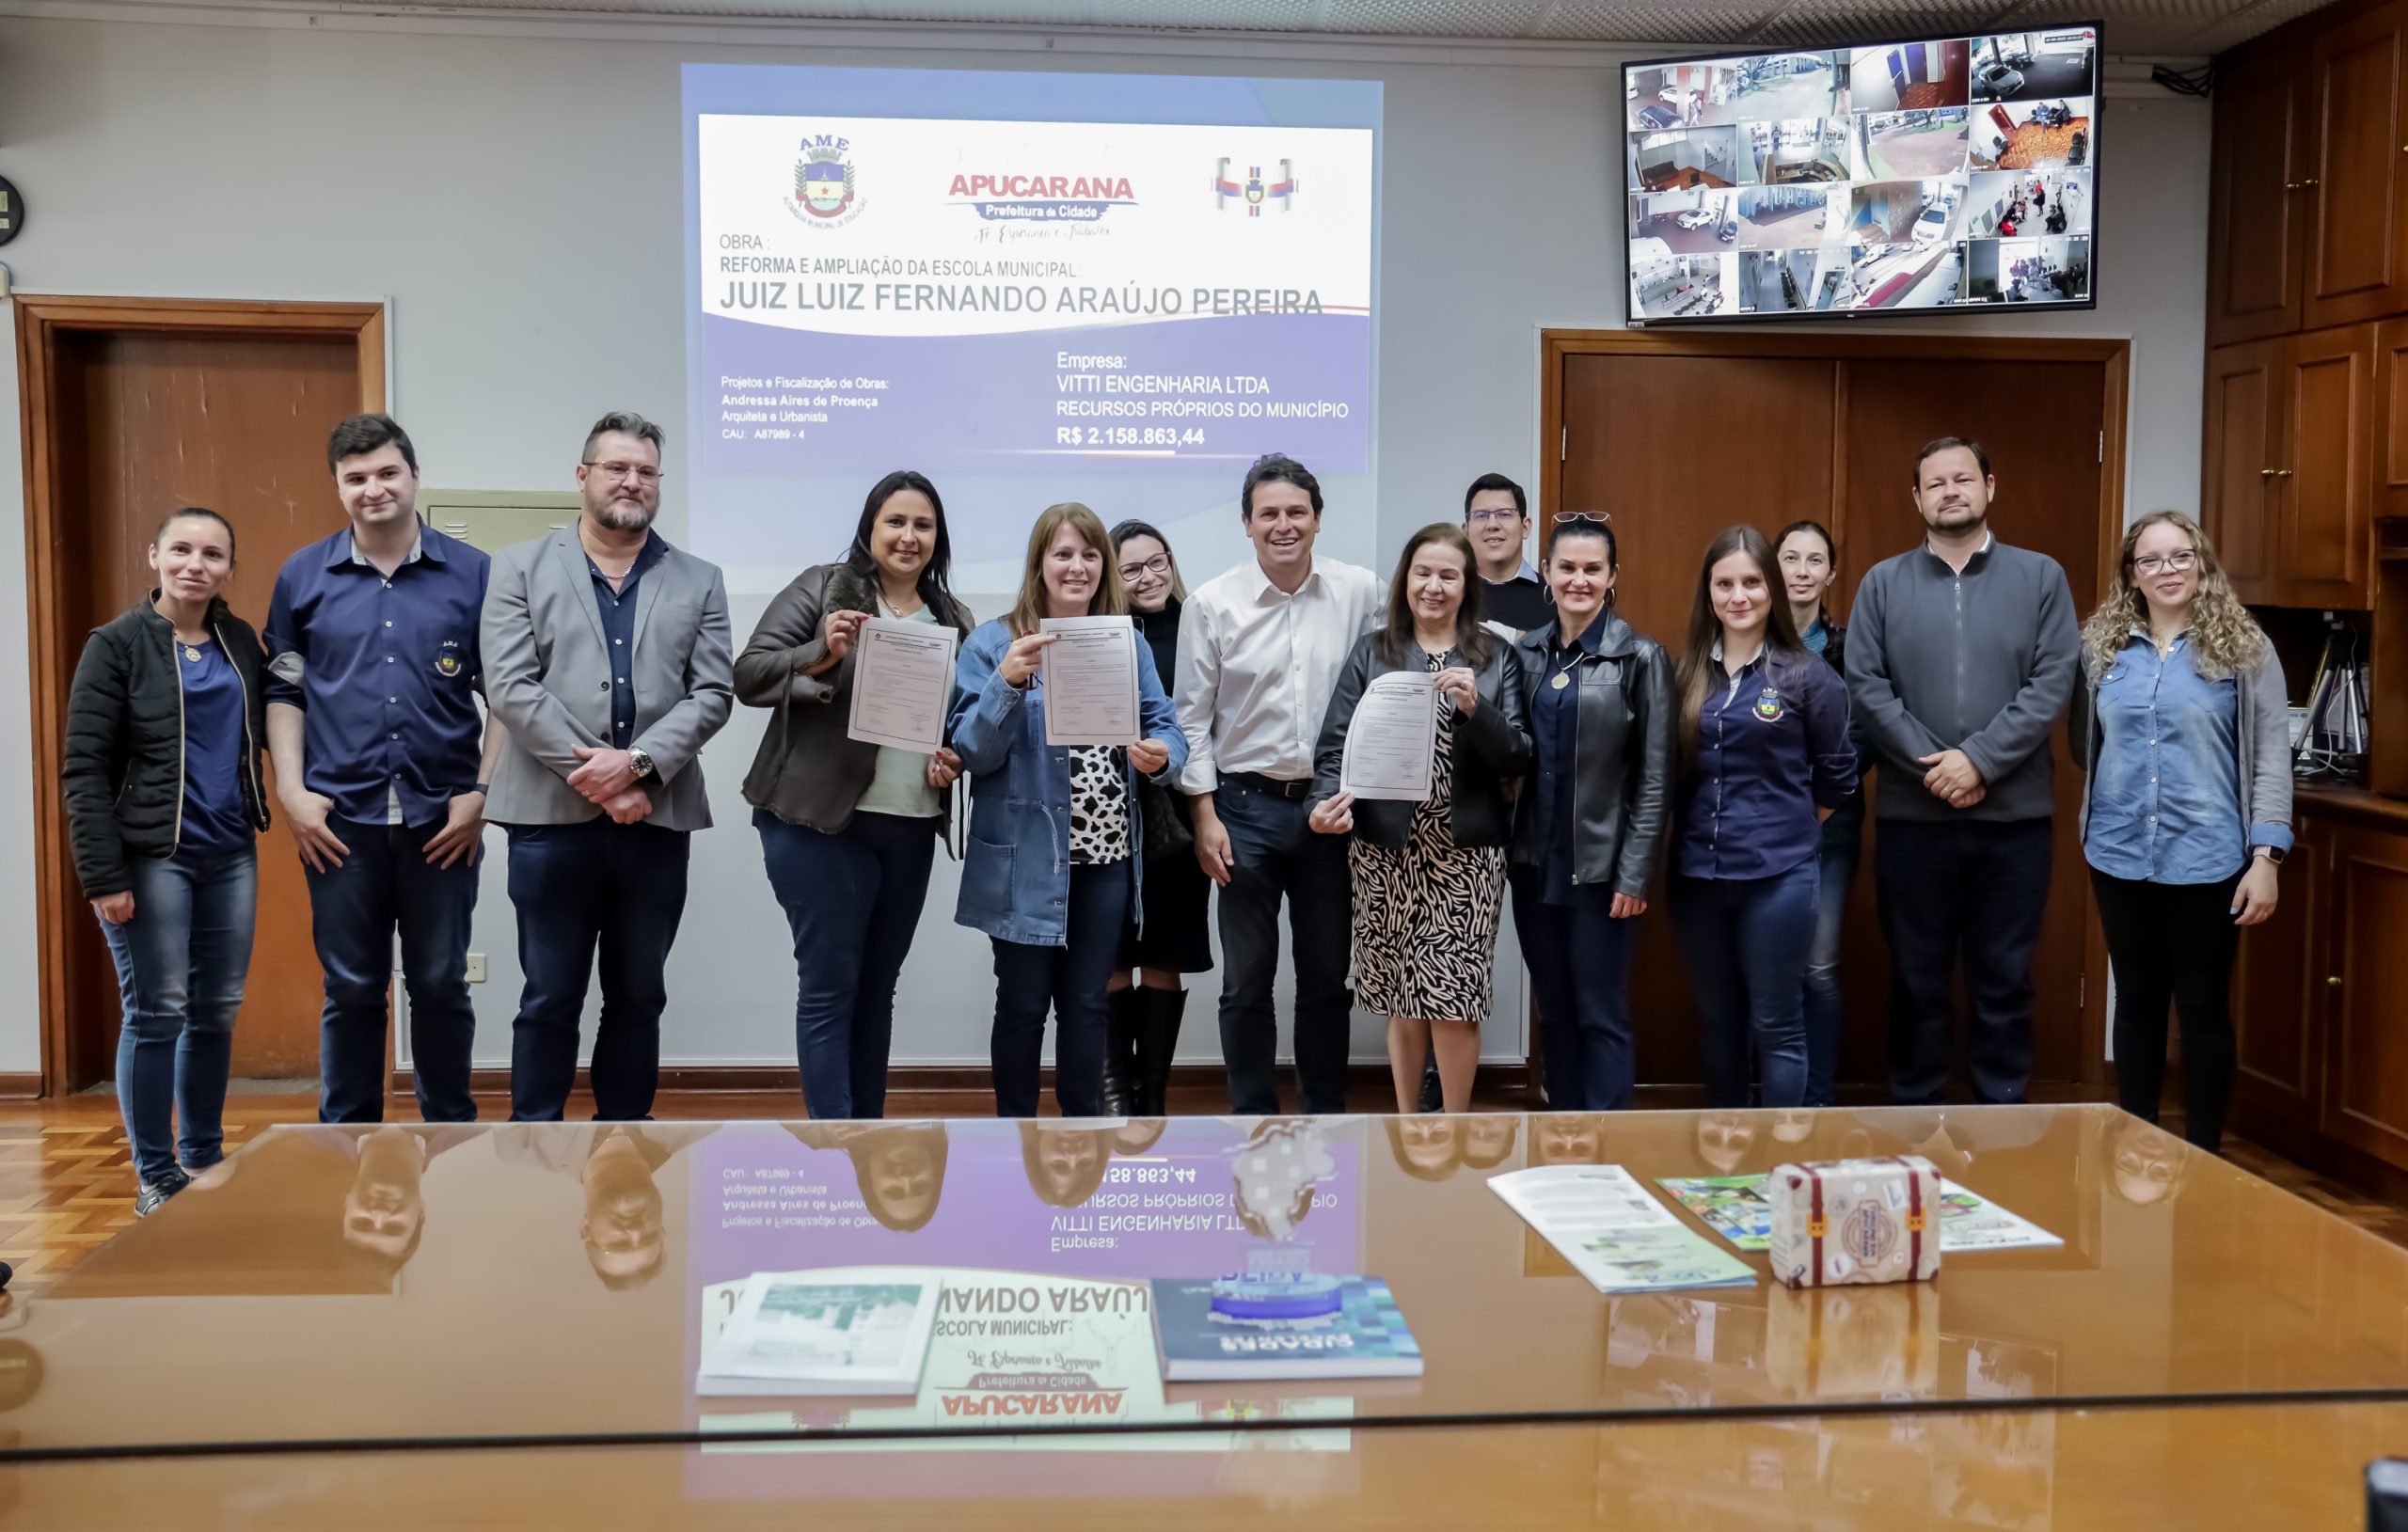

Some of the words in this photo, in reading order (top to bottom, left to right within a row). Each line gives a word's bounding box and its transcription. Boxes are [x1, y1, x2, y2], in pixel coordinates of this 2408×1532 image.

[800, 134, 850, 151] AME
[948, 174, 1134, 199] APUCARANA
[986, 204, 1044, 217] Prefeitura
[1058, 205, 1097, 218] Cidade
[720, 234, 764, 250] OBRA
[721, 256, 796, 274] REFORMA
[800, 258, 809, 274] E
[813, 256, 903, 278] AMPLIAÇÃO
[908, 259, 928, 276] DA
[932, 260, 993, 276] ESCOLA
[720, 282, 787, 309] JUIZ
[798, 282, 864, 310] LUIZ
[875, 284, 1047, 314] FERNANDO
[1055, 280, 1182, 315] ARAÚJO
[1193, 288, 1323, 316] PEREIRA
[1056, 352, 1127, 371] Empresa:
[721, 376, 763, 390] Projetos
[766, 378, 772, 387] e
[775, 376, 837, 391] Fiscalização
[840, 377, 852, 388] de
[855, 377, 890, 389] Obras:
[1056, 375, 1100, 392] VITTI
[1105, 375, 1223, 393] ENGENHARIA
[1226, 376, 1270, 394] LTDA
[721, 394, 777, 406] Andressa
[780, 395, 810, 406] Aires
[813, 396, 827, 406] de
[831, 395, 879, 408] Proença
[1056, 401, 1147, 417] RECURSOS
[1151, 399, 1234, 418] PRÓPRIOS
[1239, 403, 1262, 418] DO
[1266, 400, 1349, 419] MUNICÍPIO
[721, 410, 768, 424] Arquiteta
[769, 412, 777, 422] e
[780, 411, 828, 422] Urbanista
[1056, 426, 1082, 445] R$
[1087, 428, 1205, 447] 2.158.863,44
